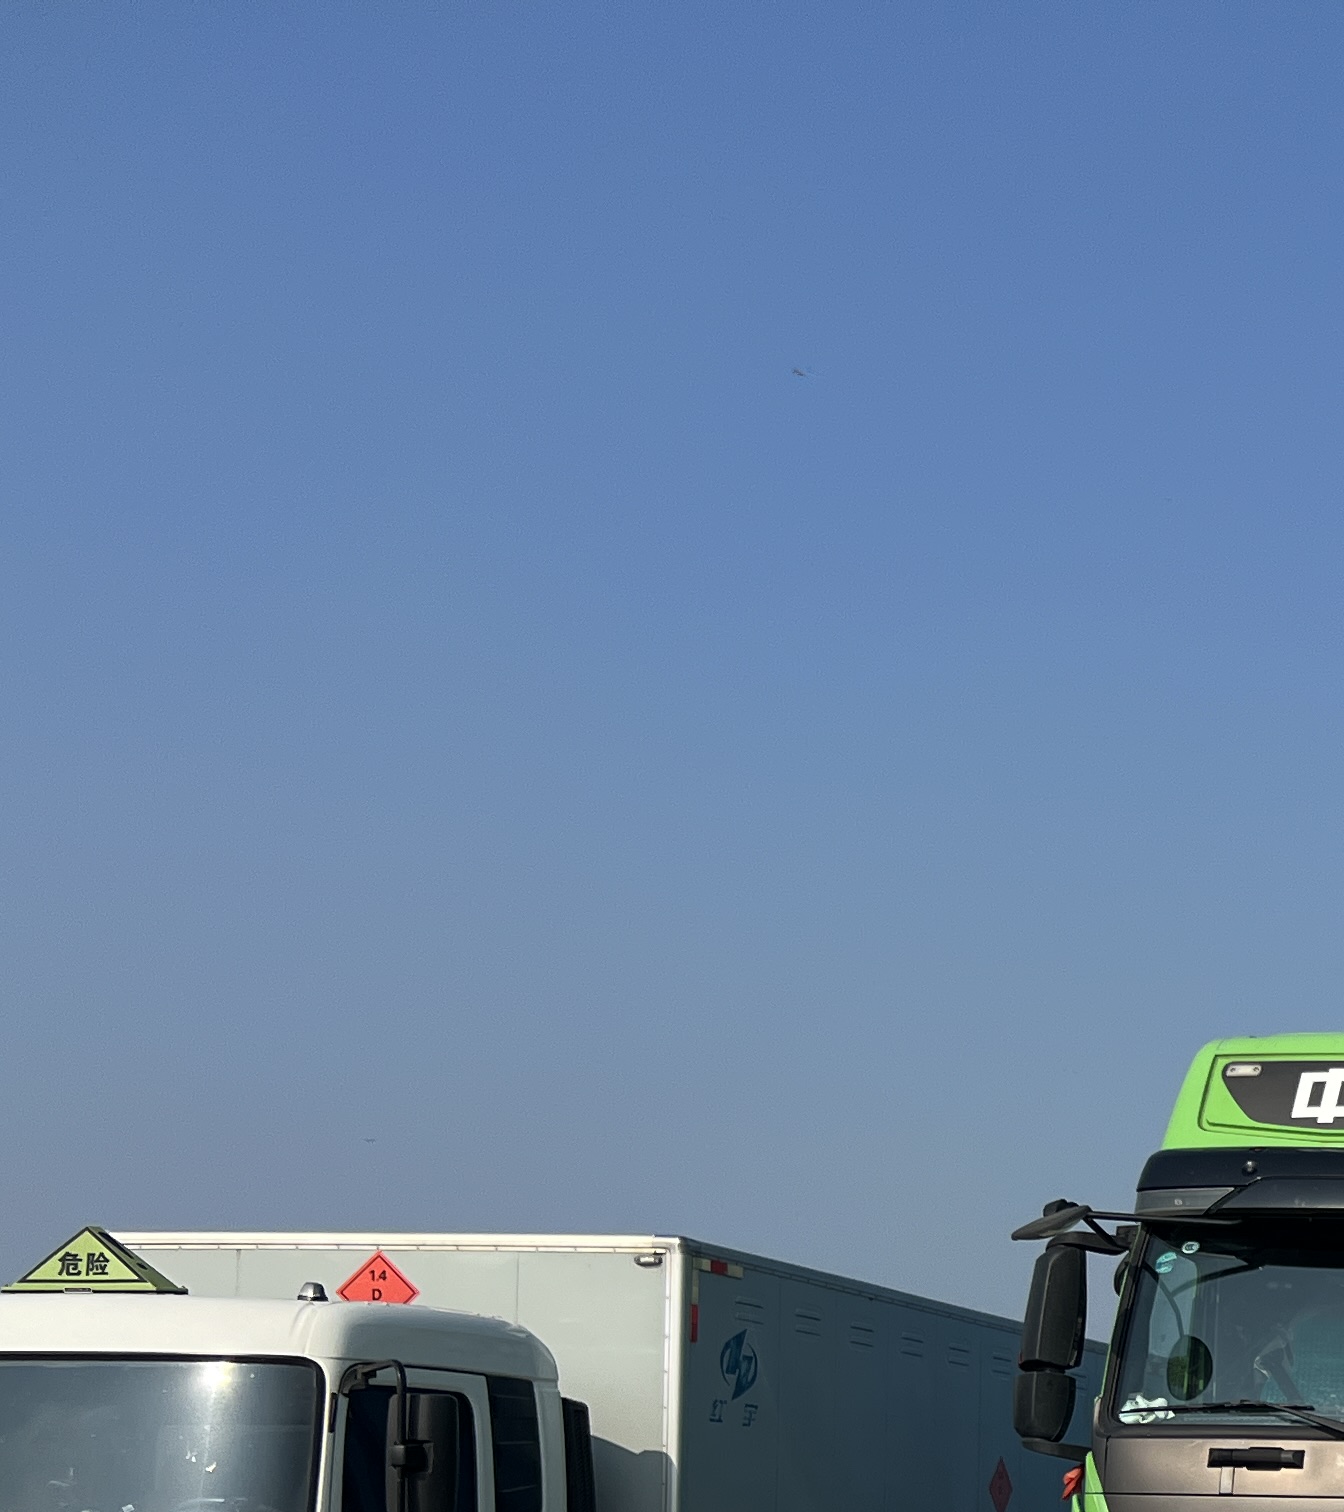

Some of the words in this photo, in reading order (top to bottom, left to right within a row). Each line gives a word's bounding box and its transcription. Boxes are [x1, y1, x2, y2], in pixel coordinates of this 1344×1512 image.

[57, 1252, 110, 1276] 危险
[369, 1270, 387, 1281] 1.4
[372, 1289, 382, 1301] D
